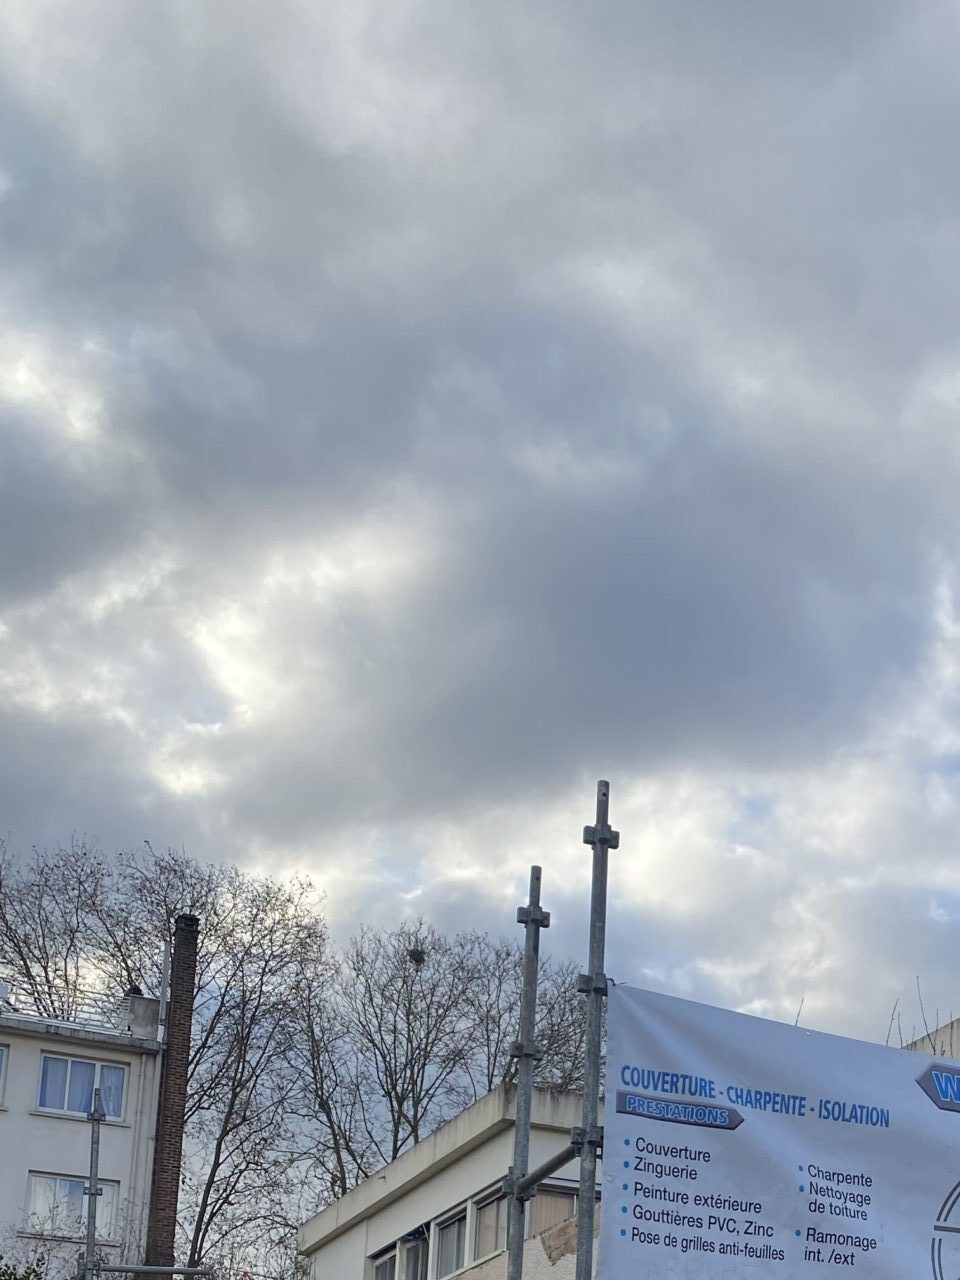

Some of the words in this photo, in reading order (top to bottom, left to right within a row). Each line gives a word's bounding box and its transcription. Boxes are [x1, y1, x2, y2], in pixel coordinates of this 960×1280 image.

[621, 1065, 716, 1099] COUVERTURE
[727, 1086, 807, 1117] CHARPENTE
[818, 1099, 890, 1128] ISOLATION
[626, 1095, 729, 1125] PRESTATIONS
[635, 1137, 711, 1163] Couverture
[634, 1157, 698, 1180] Zinguerie
[808, 1164, 873, 1188] Charpente
[634, 1182, 689, 1205] Peinture
[694, 1194, 762, 1214] extérieure
[809, 1181, 872, 1206] Nettoyage
[633, 1205, 703, 1229] Gouttières
[708, 1216, 740, 1236] PVC,
[744, 1220, 774, 1238] Zinc
[808, 1199, 826, 1214] de
[829, 1203, 868, 1221] toiture
[631, 1227, 660, 1245] Pose
[664, 1234, 678, 1248] de
[681, 1236, 716, 1254] grilles
[719, 1240, 785, 1261] anti-feuilles
[806, 1227, 877, 1250] Ramonage
[804, 1247, 825, 1263] int.
[828, 1249, 855, 1266] /ext
